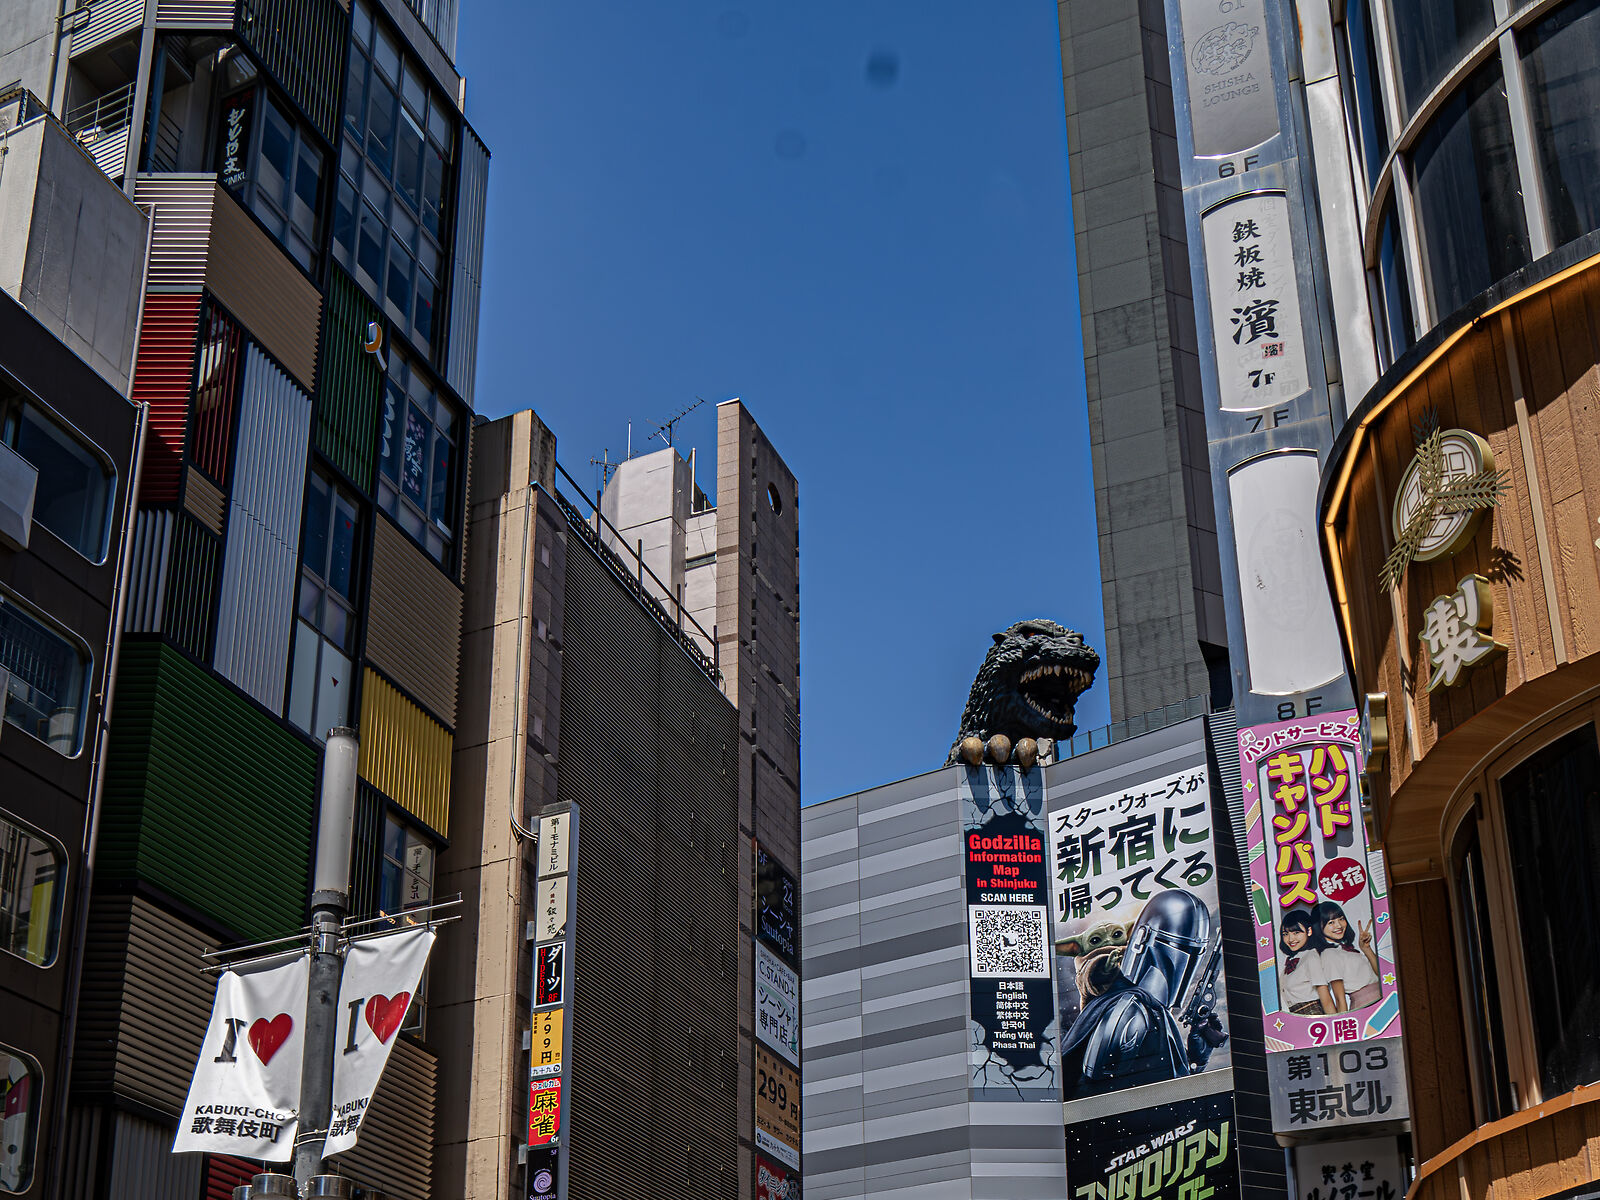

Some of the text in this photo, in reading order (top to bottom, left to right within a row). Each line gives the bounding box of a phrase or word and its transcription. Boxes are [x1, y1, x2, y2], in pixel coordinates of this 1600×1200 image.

[1202, 83, 1260, 108] LOUNGE
[1204, 72, 1255, 95] SHISHA
[1232, 219, 1266, 292] 鉄板焼
[1230, 299, 1280, 345] 濱
[1247, 368, 1276, 388] 7F
[1419, 573, 1496, 692] 製
[1055, 771, 1206, 834] スター・ウォーズが
[1309, 744, 1352, 838] ハンド
[969, 833, 1042, 851] Godzilla
[1056, 801, 1210, 885] 新宿に
[1266, 751, 1319, 908] キャンパス
[969, 851, 1042, 863] Information
[993, 864, 1020, 878] Map
[976, 877, 1038, 891] in Shinjuku
[980, 892, 1034, 903] SCAN HERE
[1058, 850, 1214, 923] 帰ってくる
[1319, 864, 1366, 897] 新宿
[538, 947, 547, 1005] HIDEOUT
[546, 944, 563, 992] ダーツ
[996, 991, 1028, 1001] English
[998, 981, 1025, 991] 日本語
[213, 1017, 248, 1063] I
[342, 998, 366, 1057] I
[992, 1041, 1036, 1049] Phasa Thai
[993, 1030, 1034, 1041] Tiếng Việt
[1286, 1046, 1389, 1081] 第103
[531, 1090, 558, 1138] 麻雀
[1287, 1079, 1393, 1125] 東京ビル
[190, 1116, 283, 1143] 歌舞伎町
[1104, 1119, 1198, 1174] STAR WARS
[1321, 1159, 1376, 1186] 喫茶室
